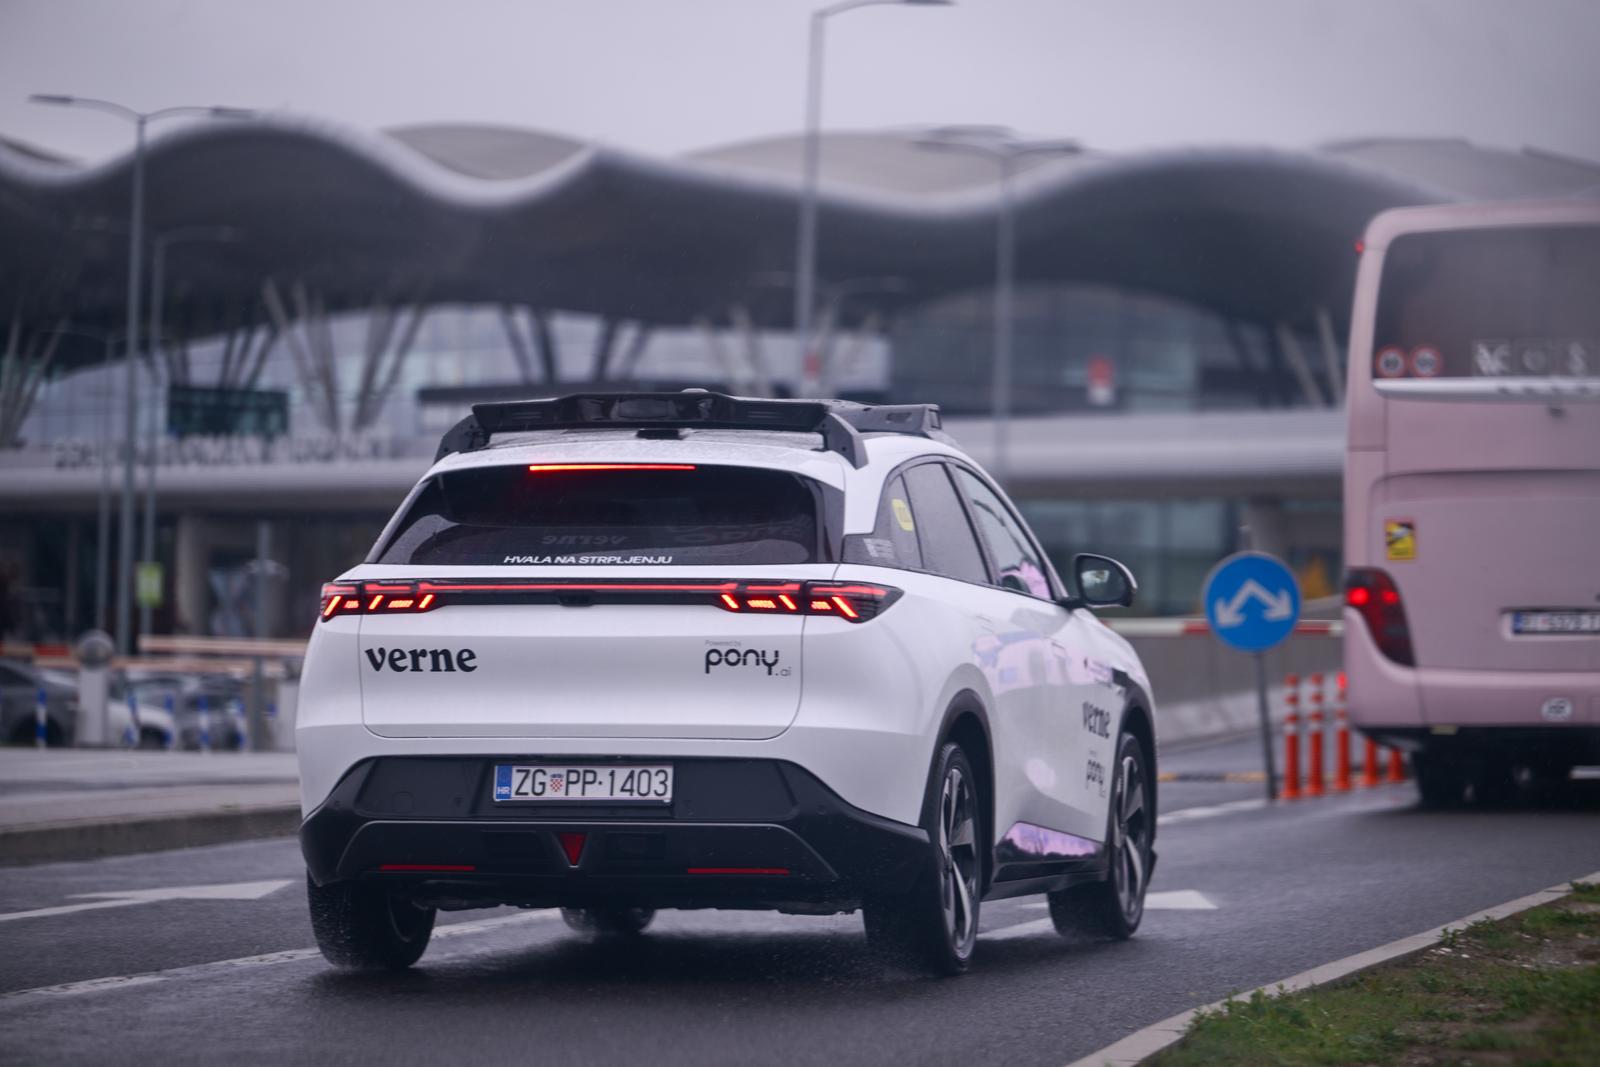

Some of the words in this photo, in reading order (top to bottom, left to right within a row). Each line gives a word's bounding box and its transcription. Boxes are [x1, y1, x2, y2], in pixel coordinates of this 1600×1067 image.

[503, 555, 551, 564] HVALA
[554, 555, 576, 564] NA
[578, 555, 673, 565] STRPLJENJU
[364, 647, 478, 673] verne
[514, 768, 547, 796] ZG
